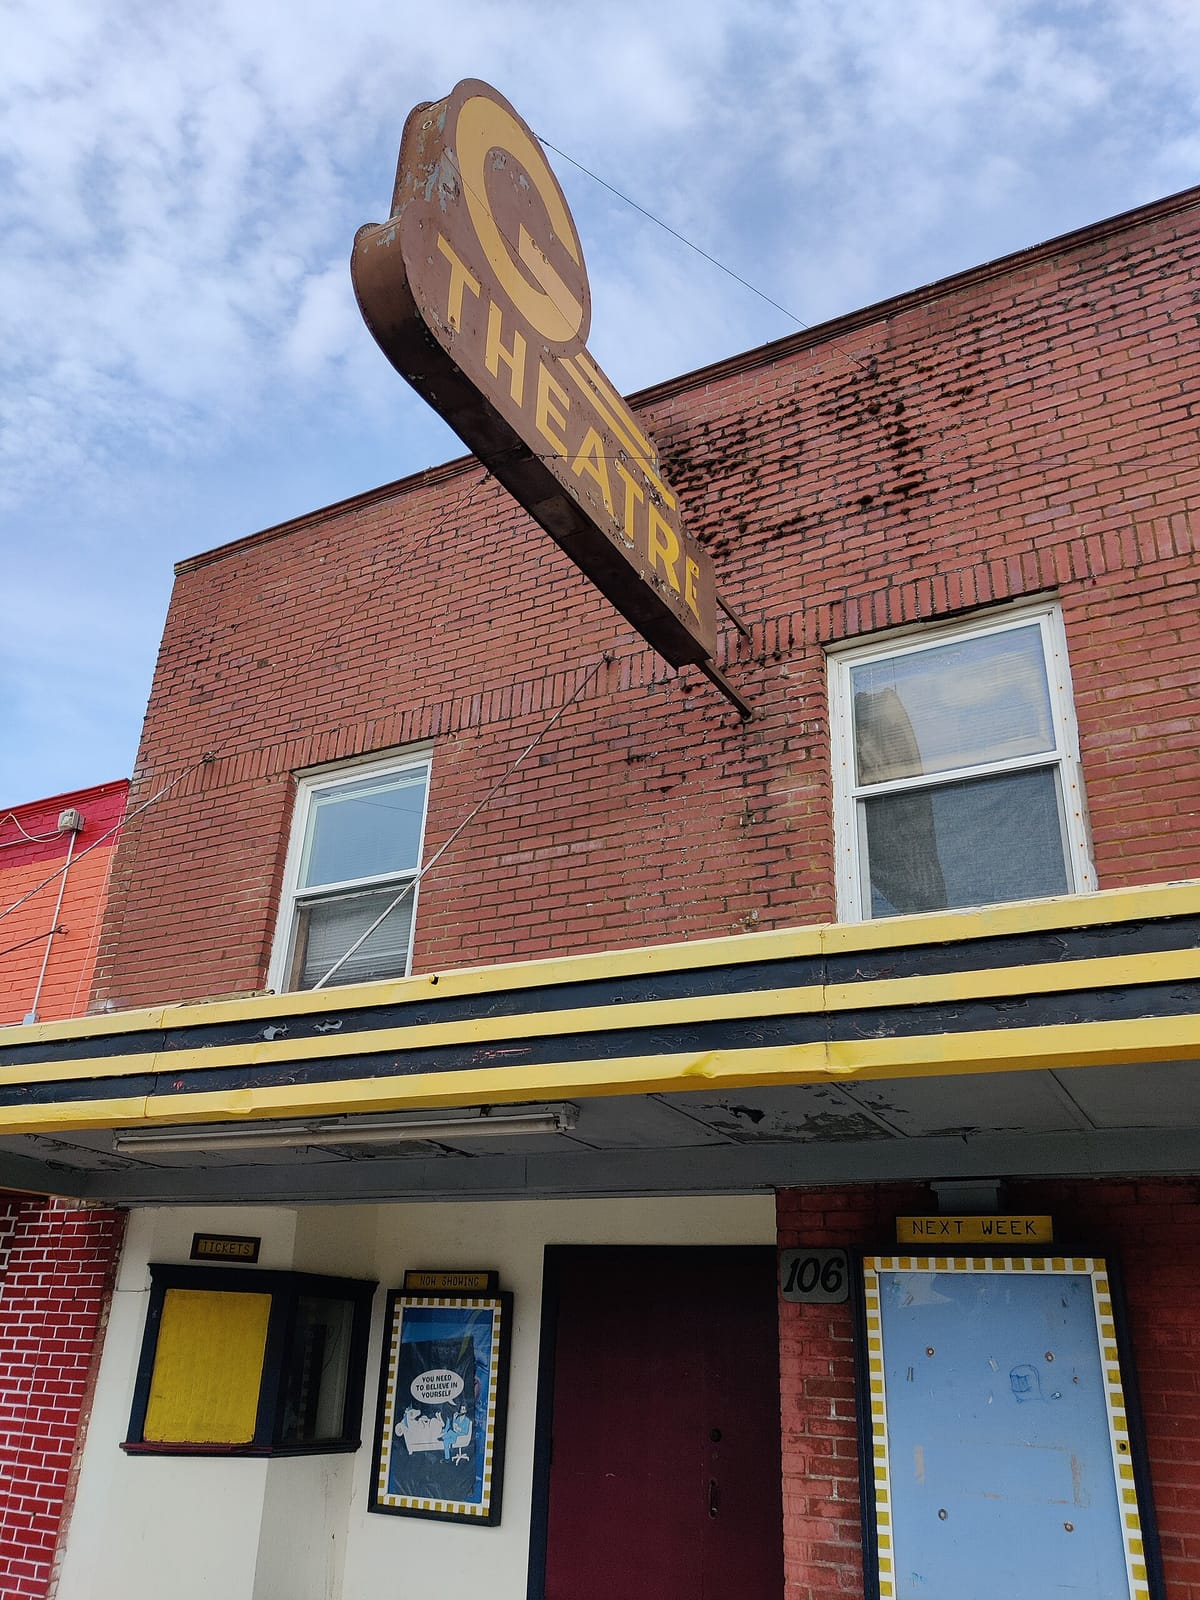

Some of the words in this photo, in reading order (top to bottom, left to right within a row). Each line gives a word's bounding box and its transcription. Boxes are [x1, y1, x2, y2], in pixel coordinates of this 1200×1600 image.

[436, 233, 702, 626] THEATRE
[912, 1219, 962, 1235] NEXT
[982, 1219, 1037, 1235] WEEK
[201, 1240, 250, 1254] TICKETS
[419, 1275, 436, 1287] NOW
[441, 1275, 480, 1288] SHOWING
[783, 1256, 844, 1293] 106
[422, 1390, 451, 1398] YOURSELF
